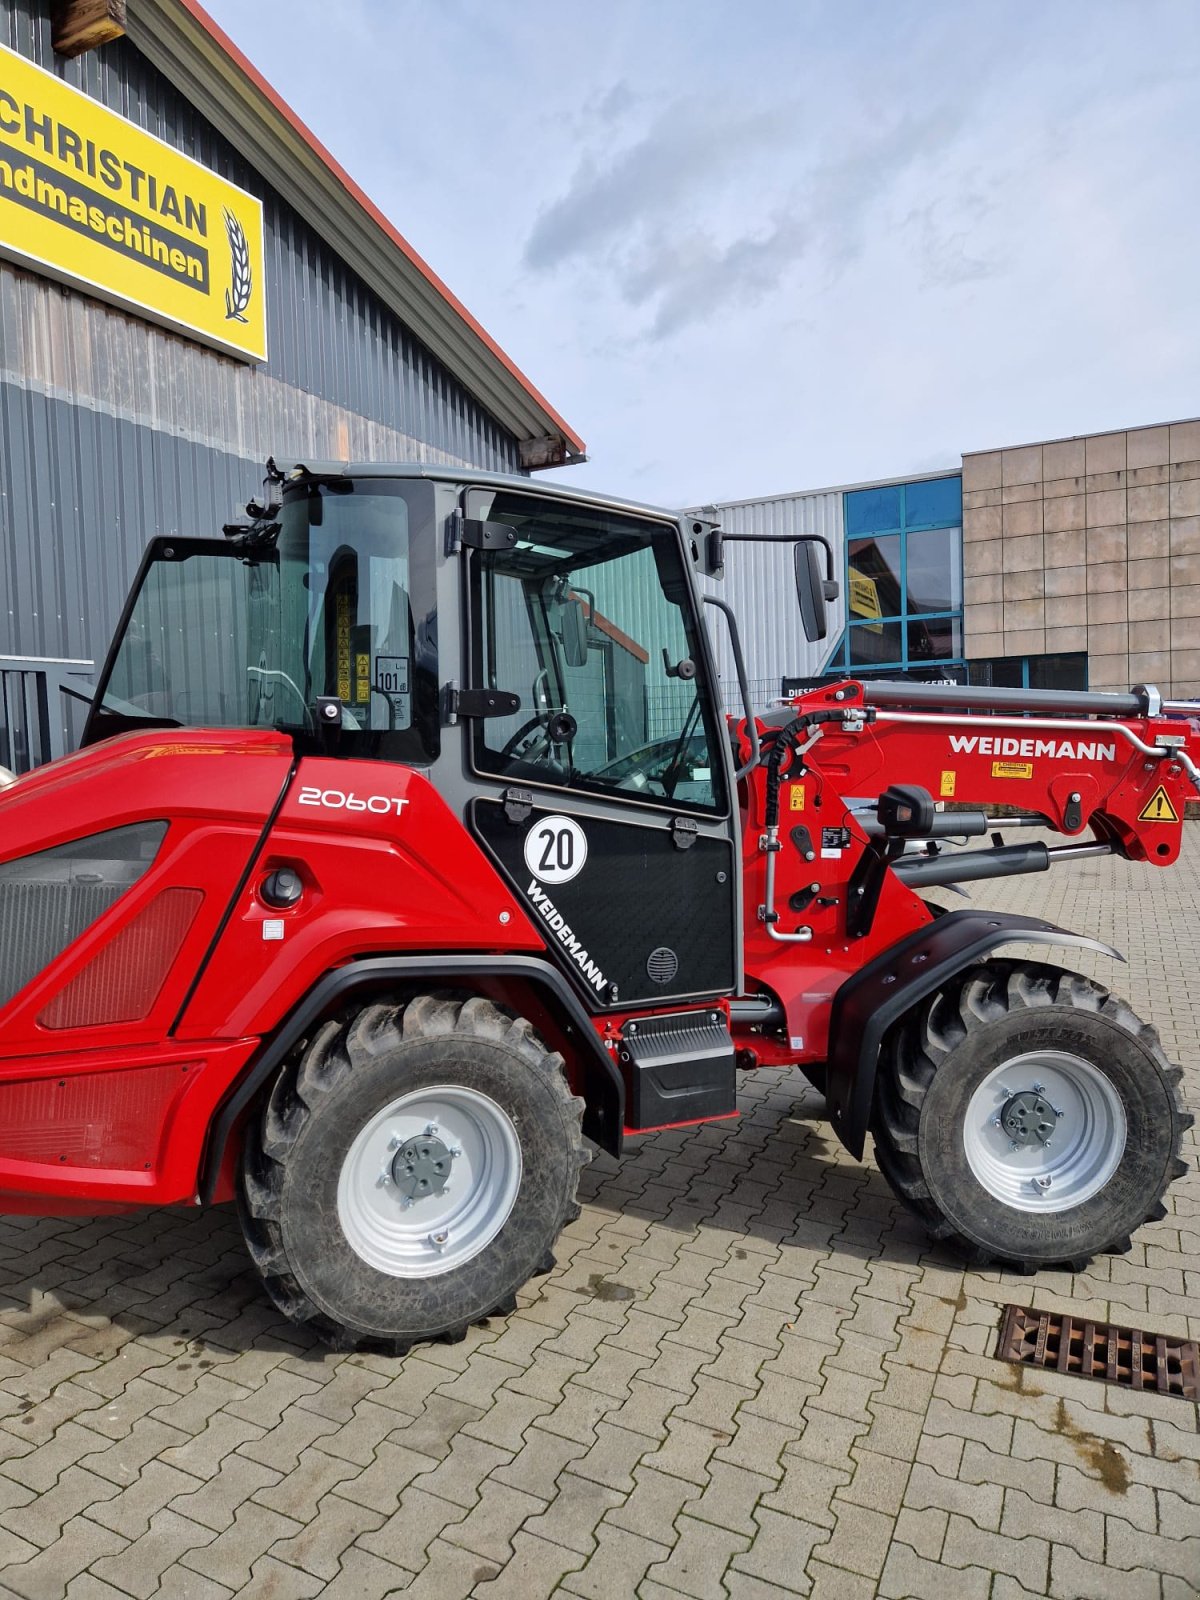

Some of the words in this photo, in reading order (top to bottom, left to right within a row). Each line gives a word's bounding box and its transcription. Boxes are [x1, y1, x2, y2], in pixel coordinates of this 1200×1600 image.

[0, 89, 207, 237] CHRISTIAN
[379, 672, 398, 691] 101
[949, 735, 1115, 761] WEIDEMANN
[298, 787, 409, 815] 2060T
[538, 828, 574, 871] 20
[526, 879, 608, 992] WEIDEMANN
